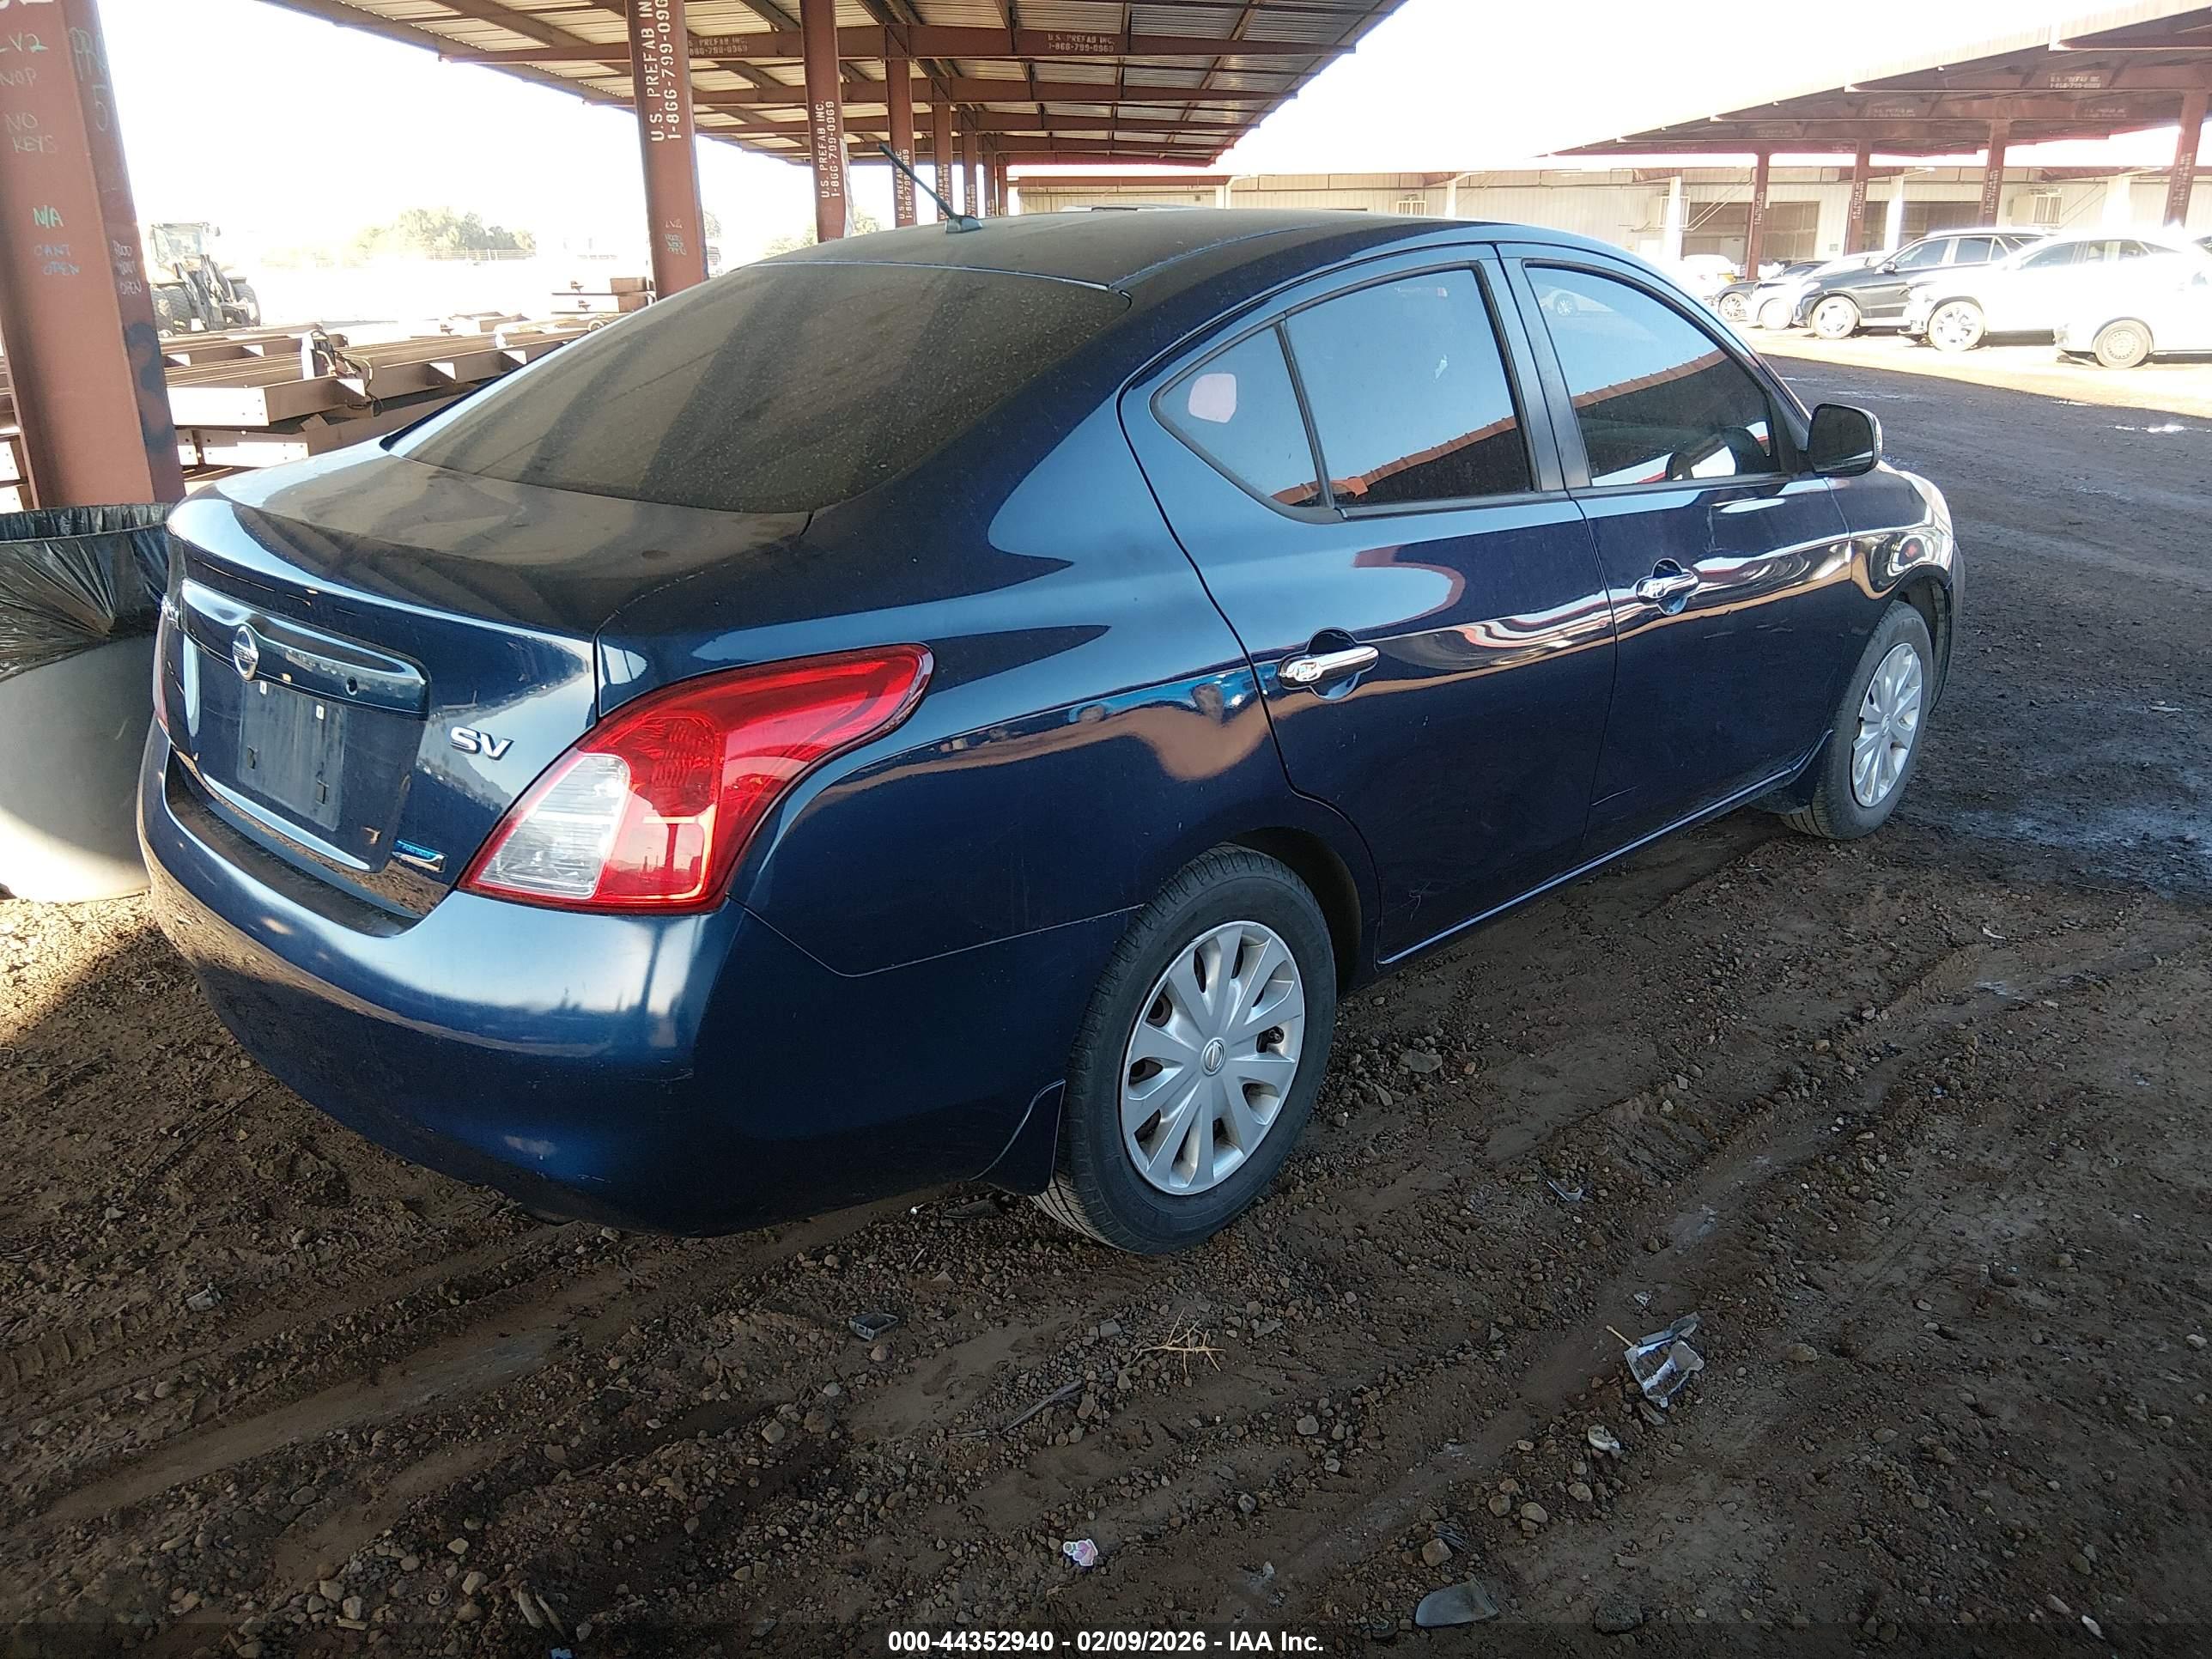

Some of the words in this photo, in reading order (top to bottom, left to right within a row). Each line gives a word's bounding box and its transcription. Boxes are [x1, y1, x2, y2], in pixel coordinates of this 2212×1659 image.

[1066, 34, 1097, 44] PREFAB
[641, 27, 661, 97] PREFAB
[649, 107, 665, 142] U.S.
[815, 100, 825, 122] INC.
[817, 127, 829, 171] PREFAB
[825, 101, 841, 197] 1-866-799-0969
[820, 176, 830, 198] U.S.
[896, 167, 905, 200] PREFAB
[33, 205, 64, 228] N/A
[451, 726, 514, 761] SV
